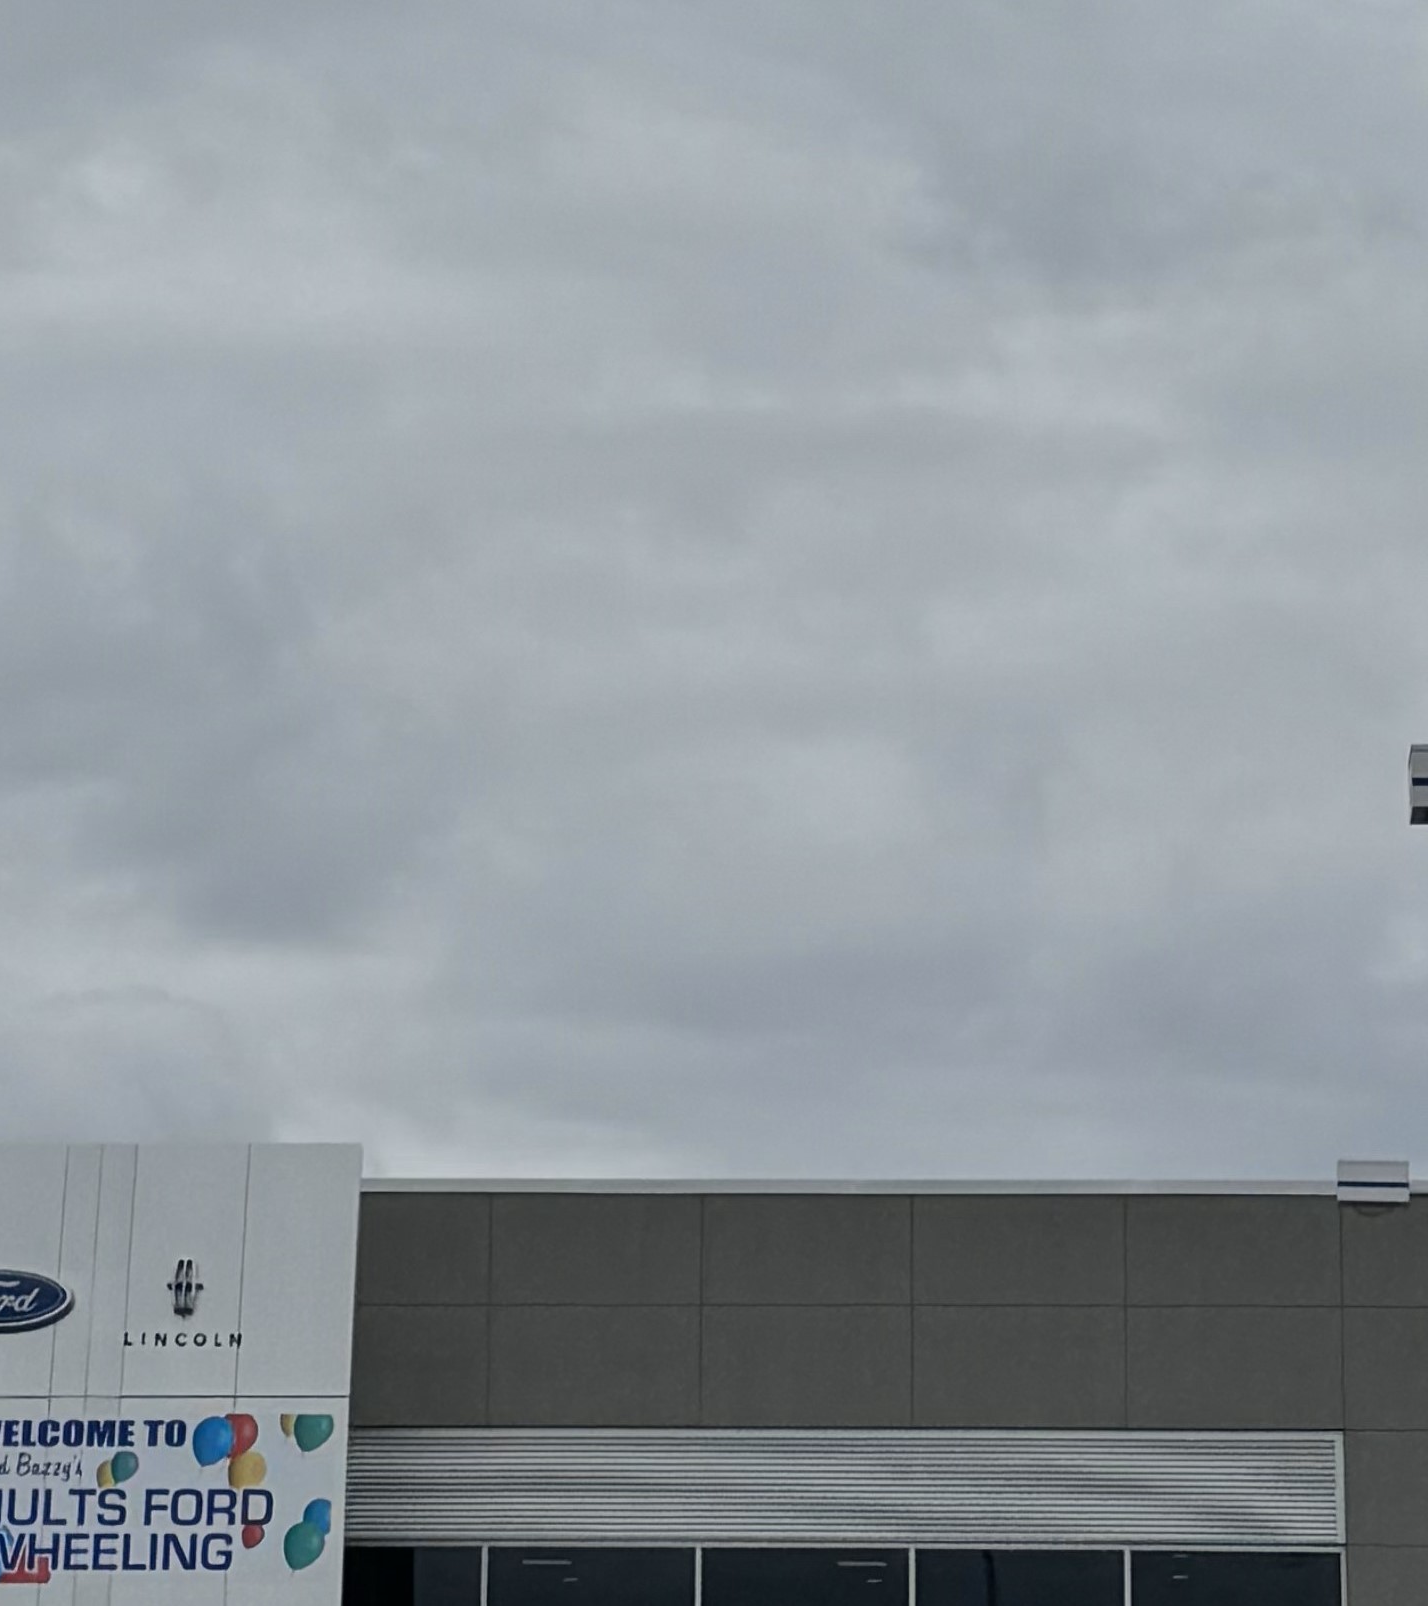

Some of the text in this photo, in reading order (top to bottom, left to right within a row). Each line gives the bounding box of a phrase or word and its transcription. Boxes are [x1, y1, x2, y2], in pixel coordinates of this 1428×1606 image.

[123, 1331, 242, 1348] LINCOLN
[142, 1419, 187, 1448] TO
[143, 1487, 274, 1527] FORD
